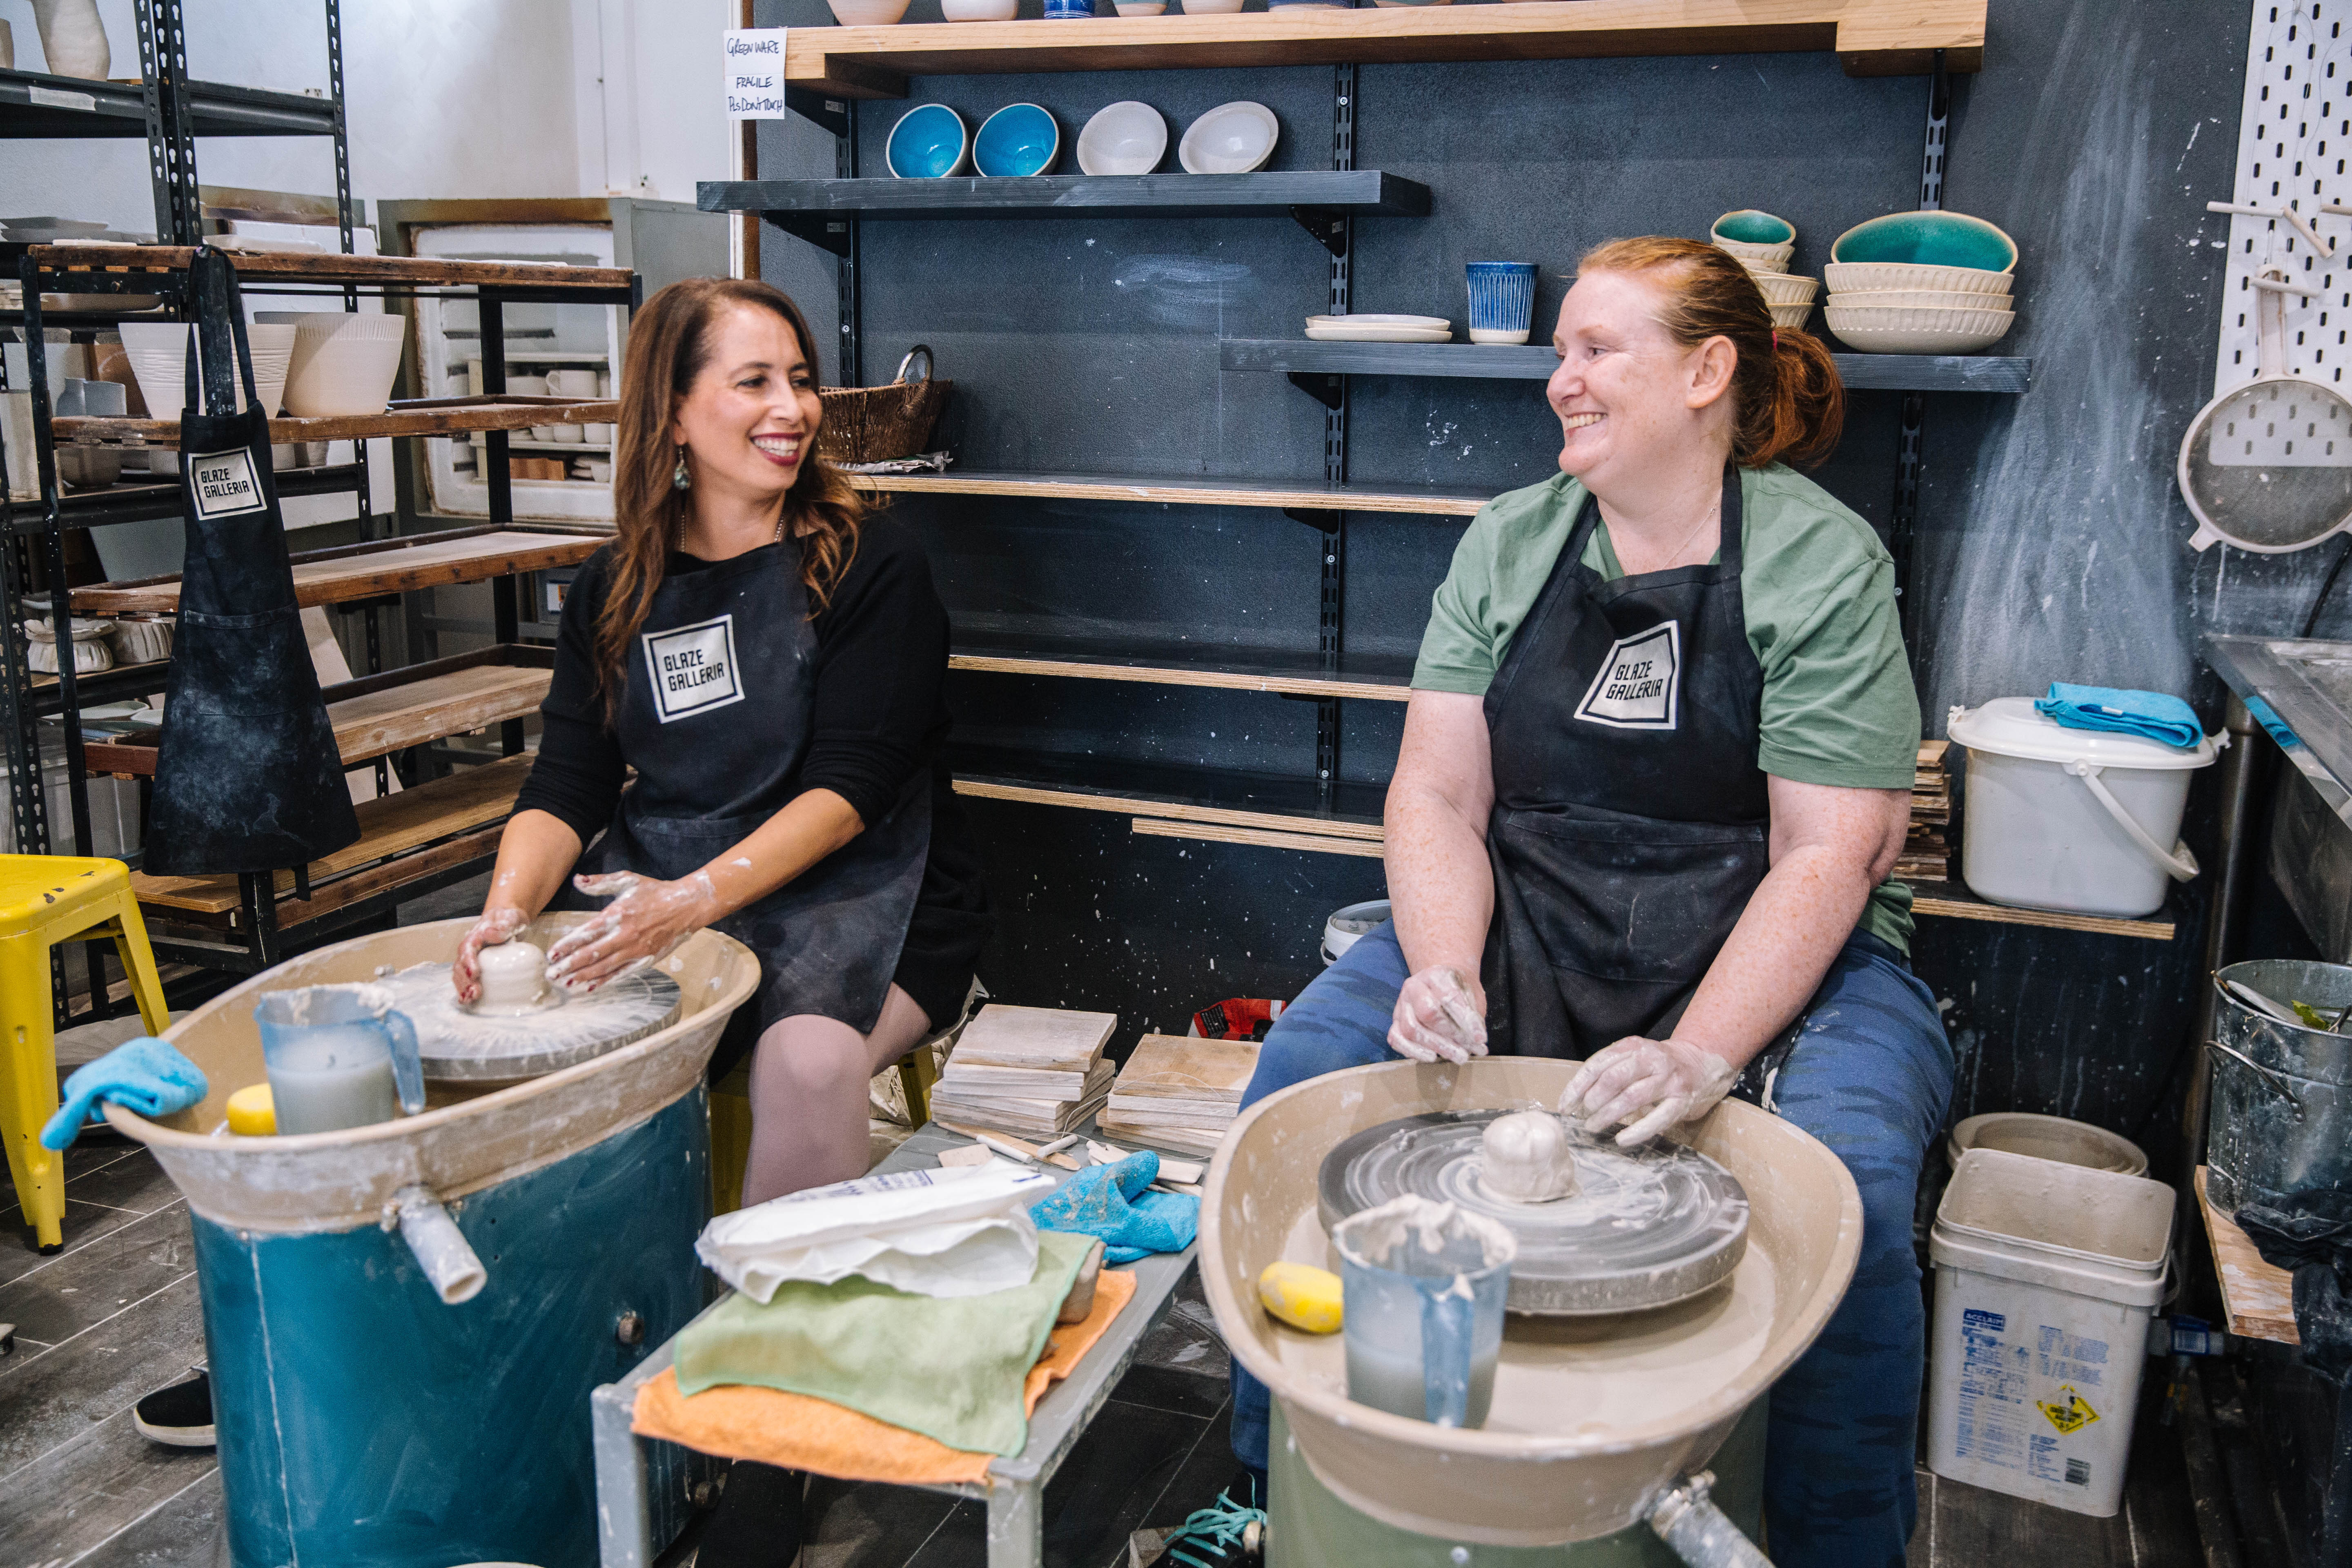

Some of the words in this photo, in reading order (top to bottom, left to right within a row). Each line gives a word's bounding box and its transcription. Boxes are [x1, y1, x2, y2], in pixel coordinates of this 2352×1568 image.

[736, 76, 773, 89] FRAGILE
[760, 98, 782, 112] TOUCH
[200, 468, 230, 483] GLAZE
[204, 480, 250, 498] GALLERIA
[664, 649, 704, 671] GLAZE
[668, 662, 724, 691] GALLERIA
[1615, 660, 1653, 680] GLAZE
[1606, 679, 1663, 700] GALLERIA
